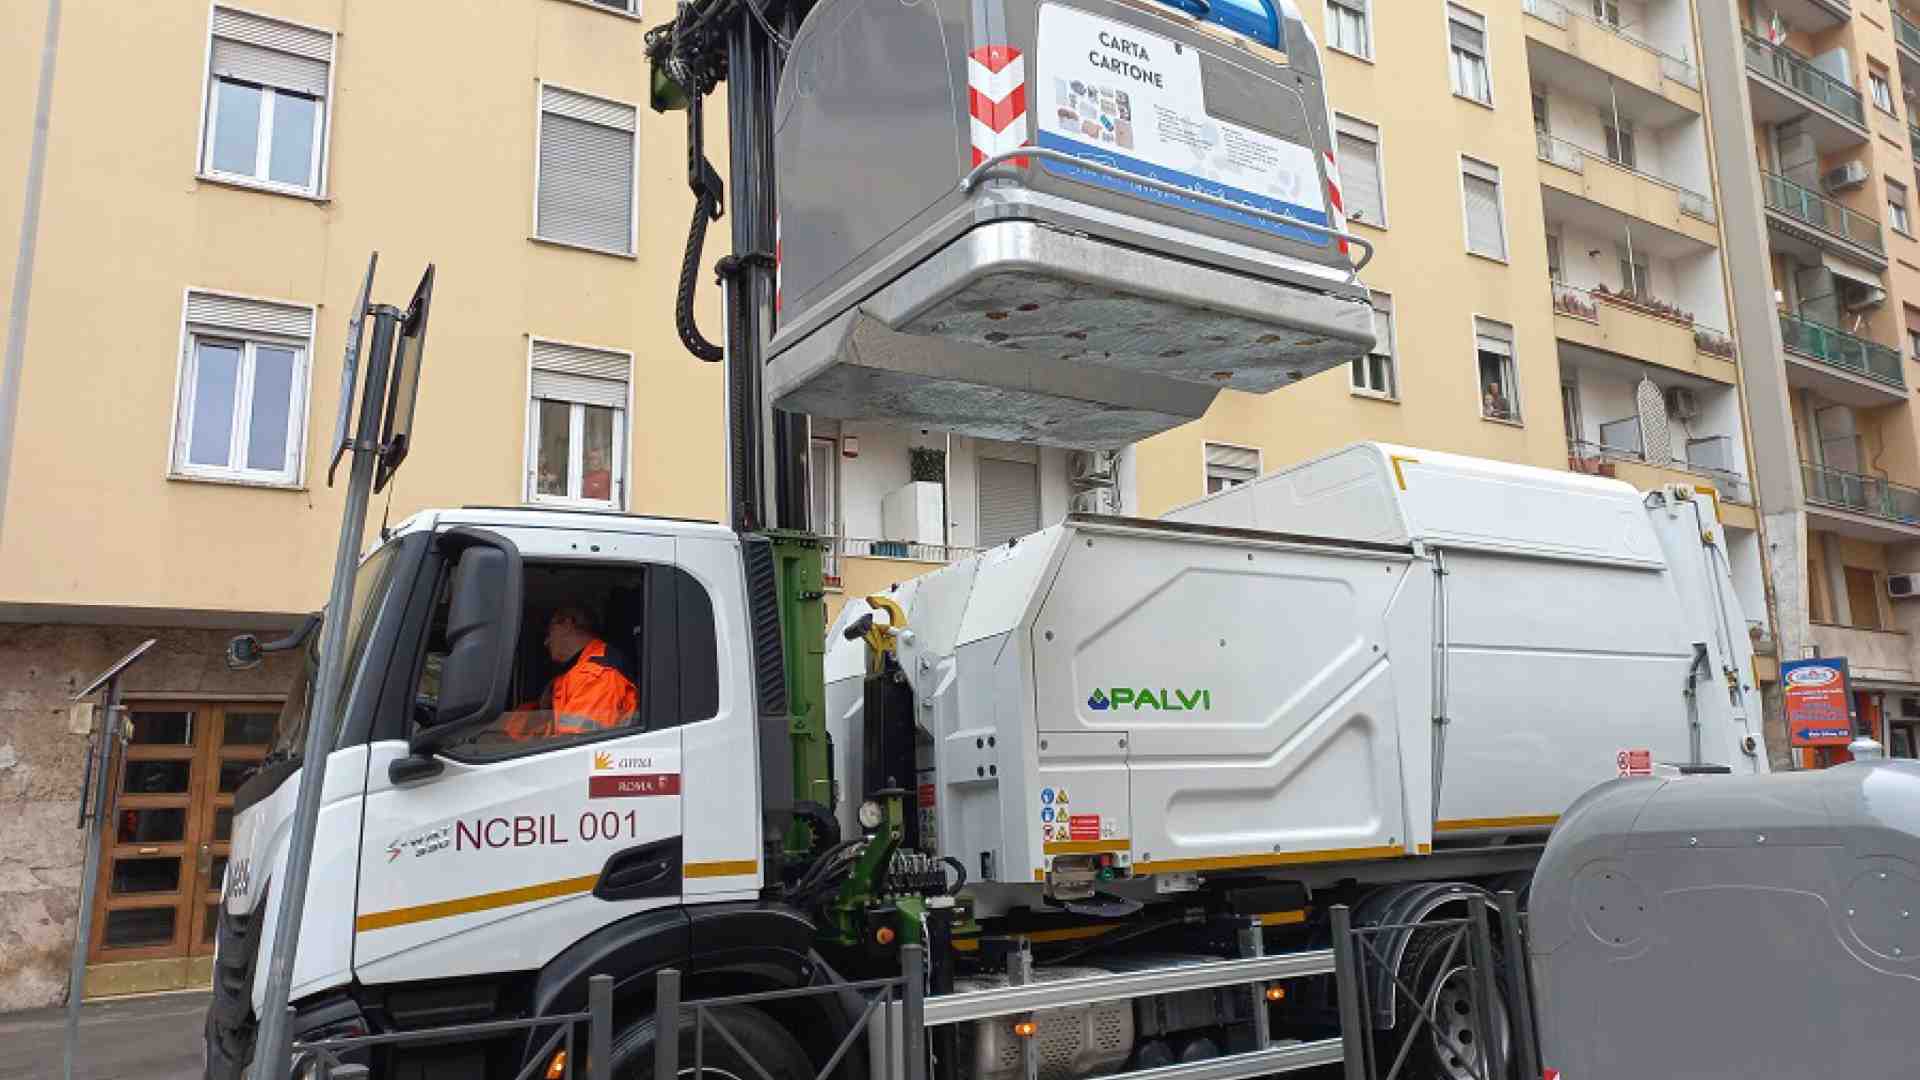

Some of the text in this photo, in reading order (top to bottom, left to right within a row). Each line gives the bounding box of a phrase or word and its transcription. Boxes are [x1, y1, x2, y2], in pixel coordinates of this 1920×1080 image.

[1099, 31, 1150, 61] CARTA
[1089, 51, 1163, 89] CARTONE
[1110, 687, 1211, 710] PALVI
[455, 809, 638, 851] NCBIL 001
